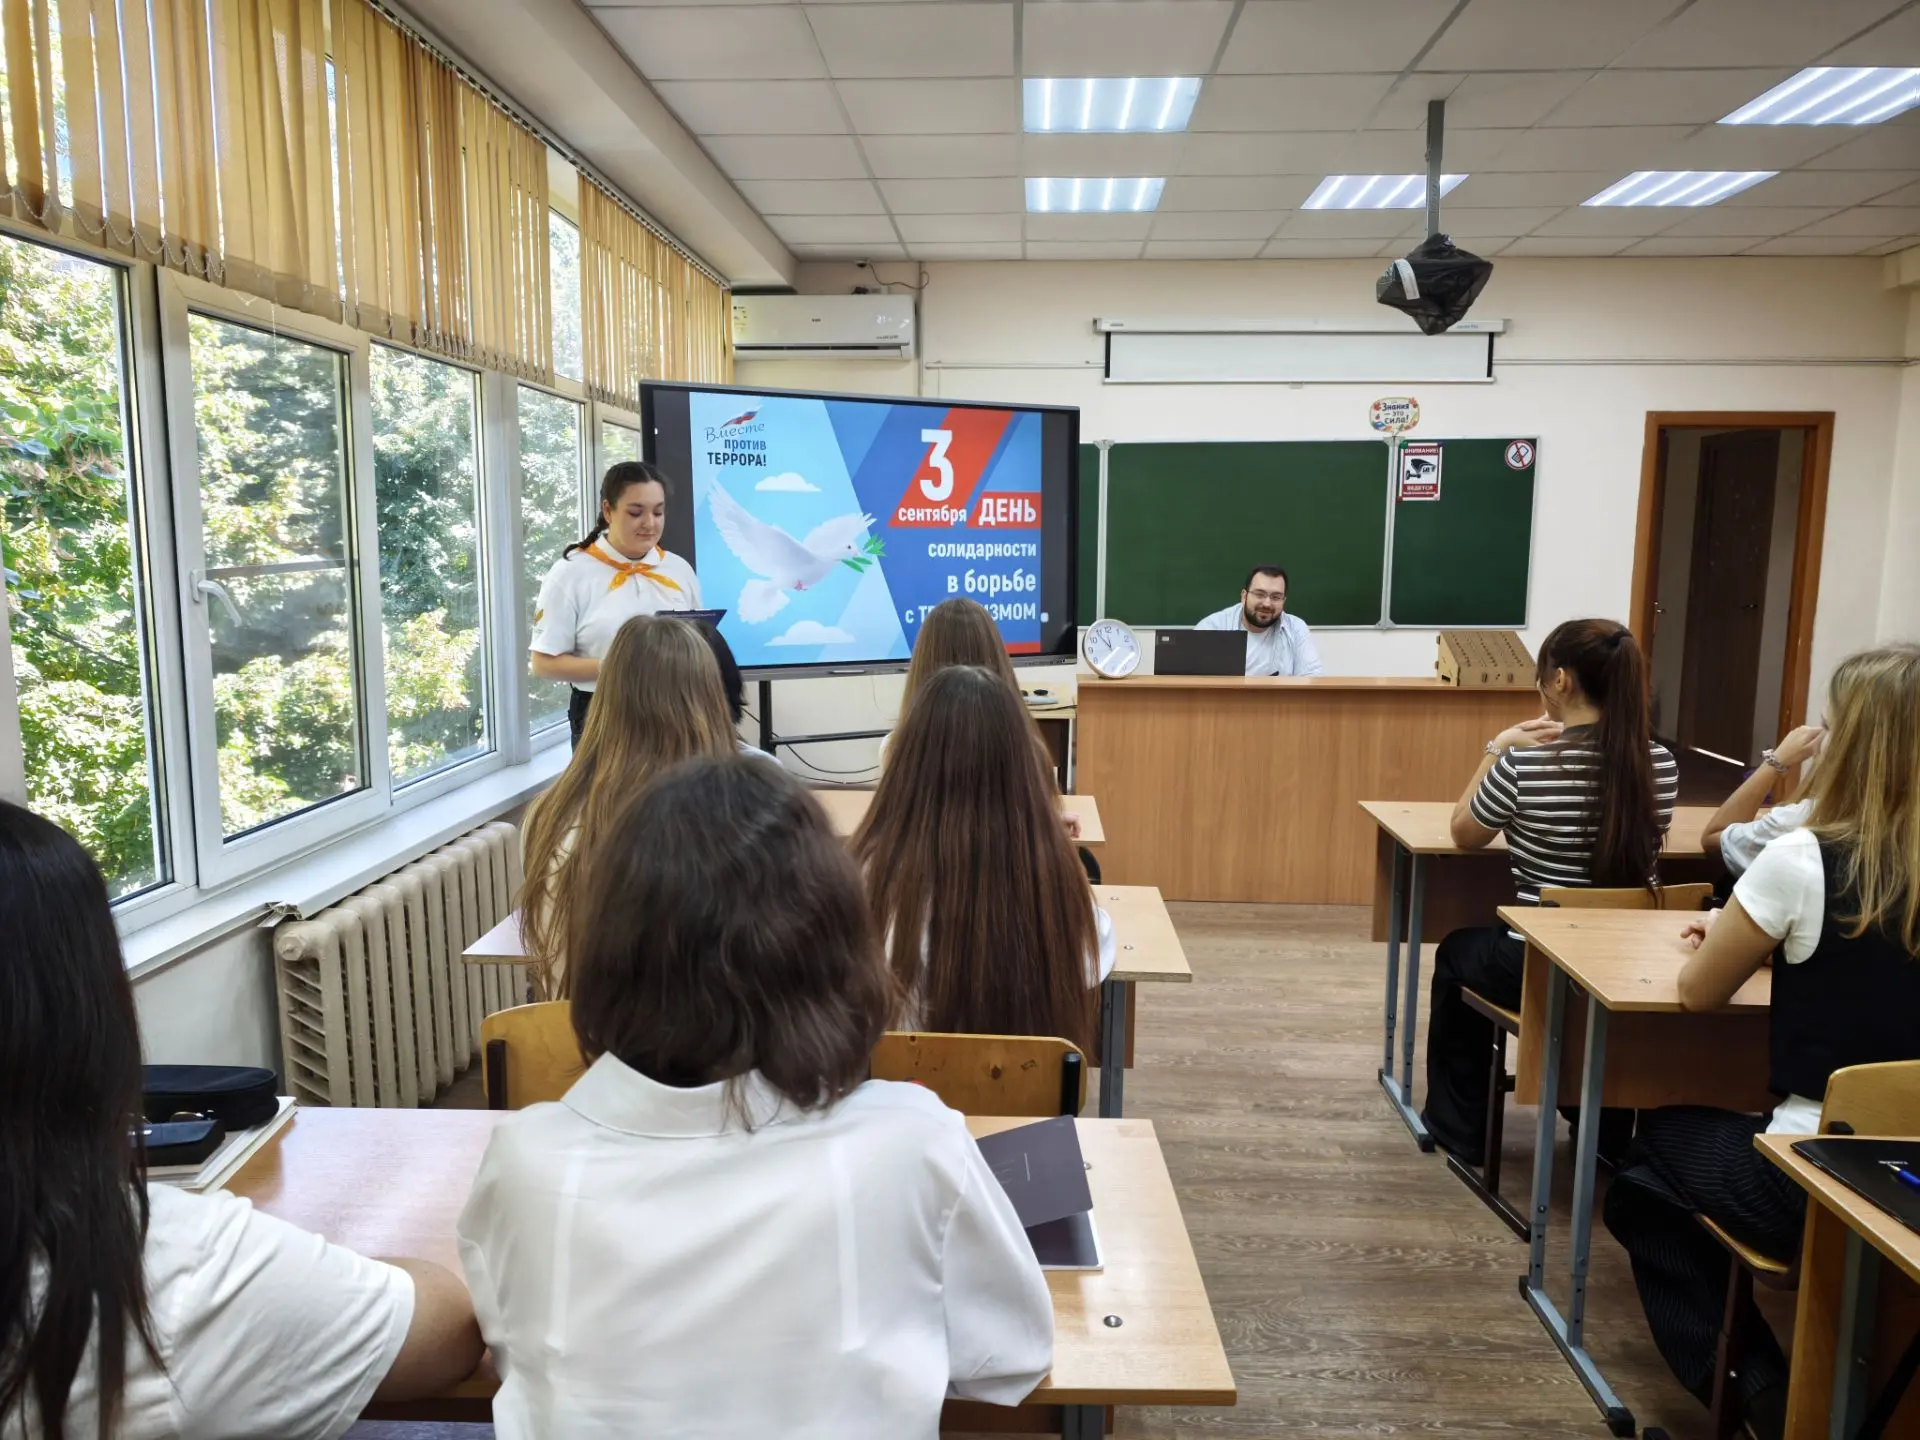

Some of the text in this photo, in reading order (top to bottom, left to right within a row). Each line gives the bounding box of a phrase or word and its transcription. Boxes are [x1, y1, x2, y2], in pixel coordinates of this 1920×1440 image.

[1381, 402, 1410, 411] Знания
[1384, 414, 1409, 424] сила!
[703, 423, 765, 443] Вместе
[724, 439, 767, 452] против
[707, 452, 767, 467] ТЕРРОРА!
[919, 428, 954, 501] 3
[898, 498, 1036, 526] сентября ДЕНЬ
[928, 543, 1037, 561] солидарности
[947, 568, 1037, 597] в борьбе
[905, 609, 915, 624] с
[1104, 625, 1112, 634] 12
[1090, 636, 1098, 644] 10
[1123, 635, 1130, 643] 2
[1088, 646, 1094, 654] 9
